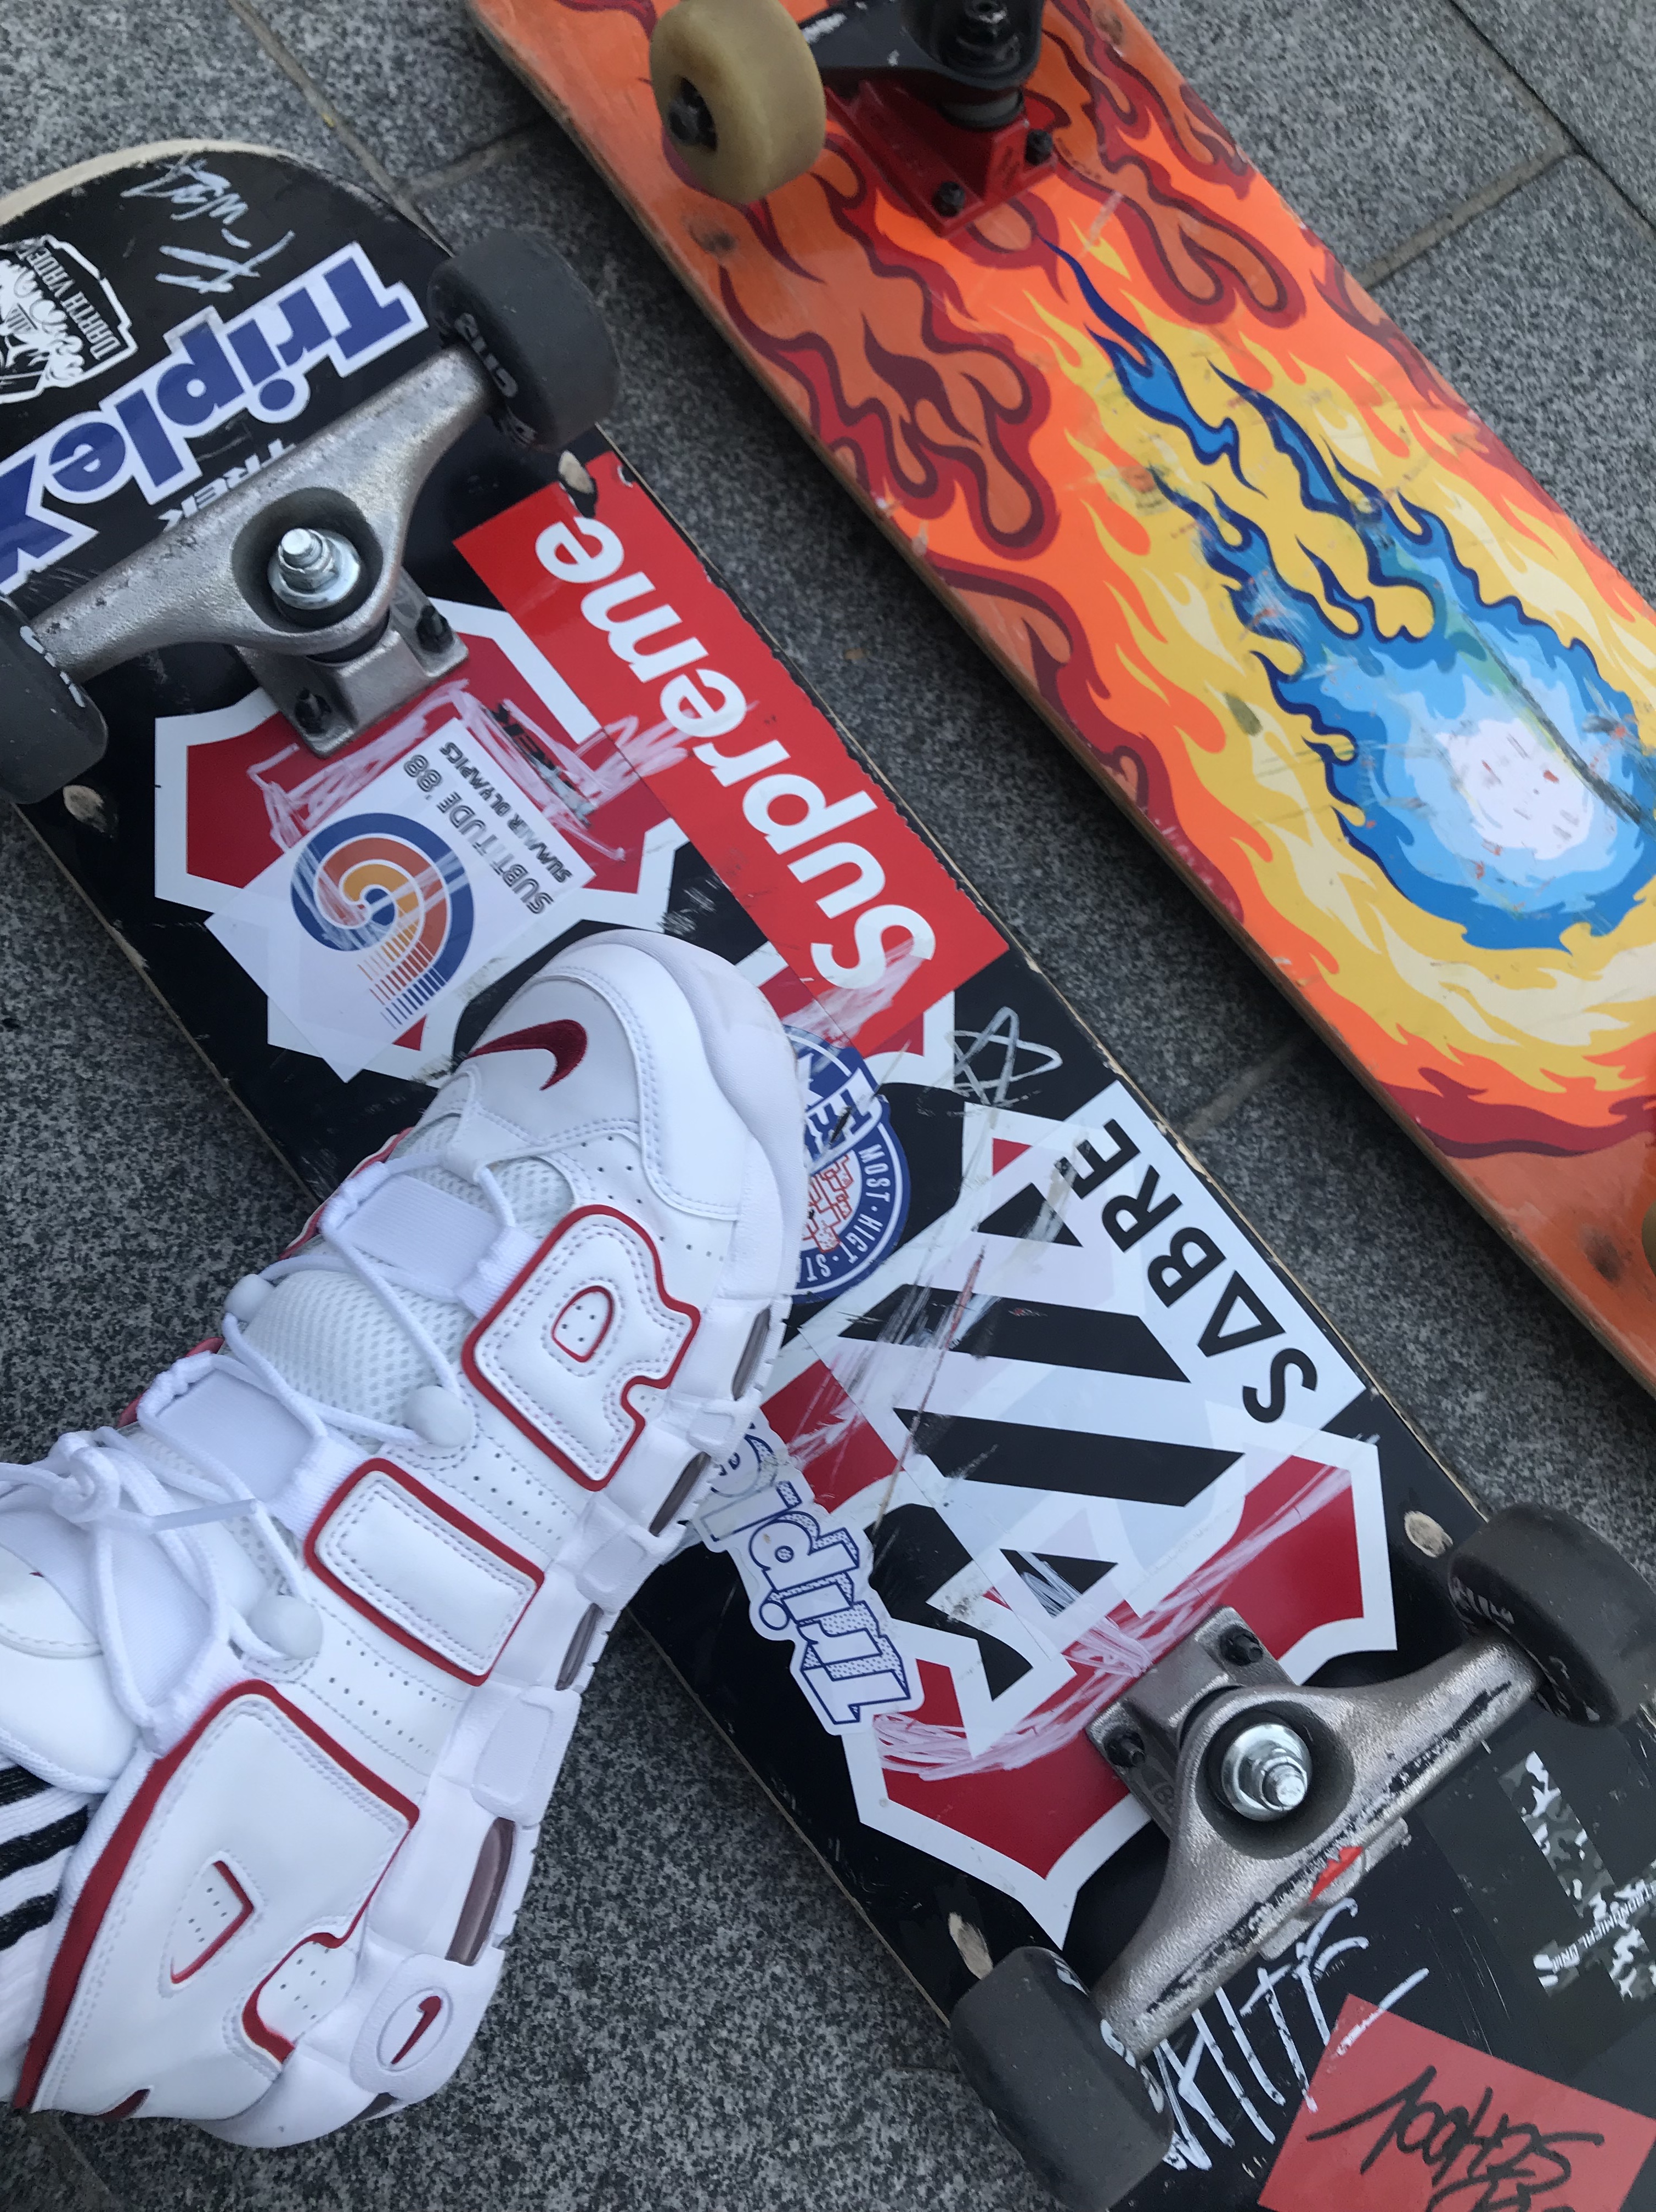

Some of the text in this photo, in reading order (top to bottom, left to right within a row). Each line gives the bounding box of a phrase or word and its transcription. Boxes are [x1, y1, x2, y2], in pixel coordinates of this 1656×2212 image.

[60, 290, 122, 361] DARTH
[157, 438, 296, 531] TREK
[403, 753, 443, 801] '88
[438, 741, 511, 816] OLYMPICS
[534, 516, 937, 990] Supreme
[858, 1143, 891, 1203] MOST
[796, 1254, 832, 1283] ST
